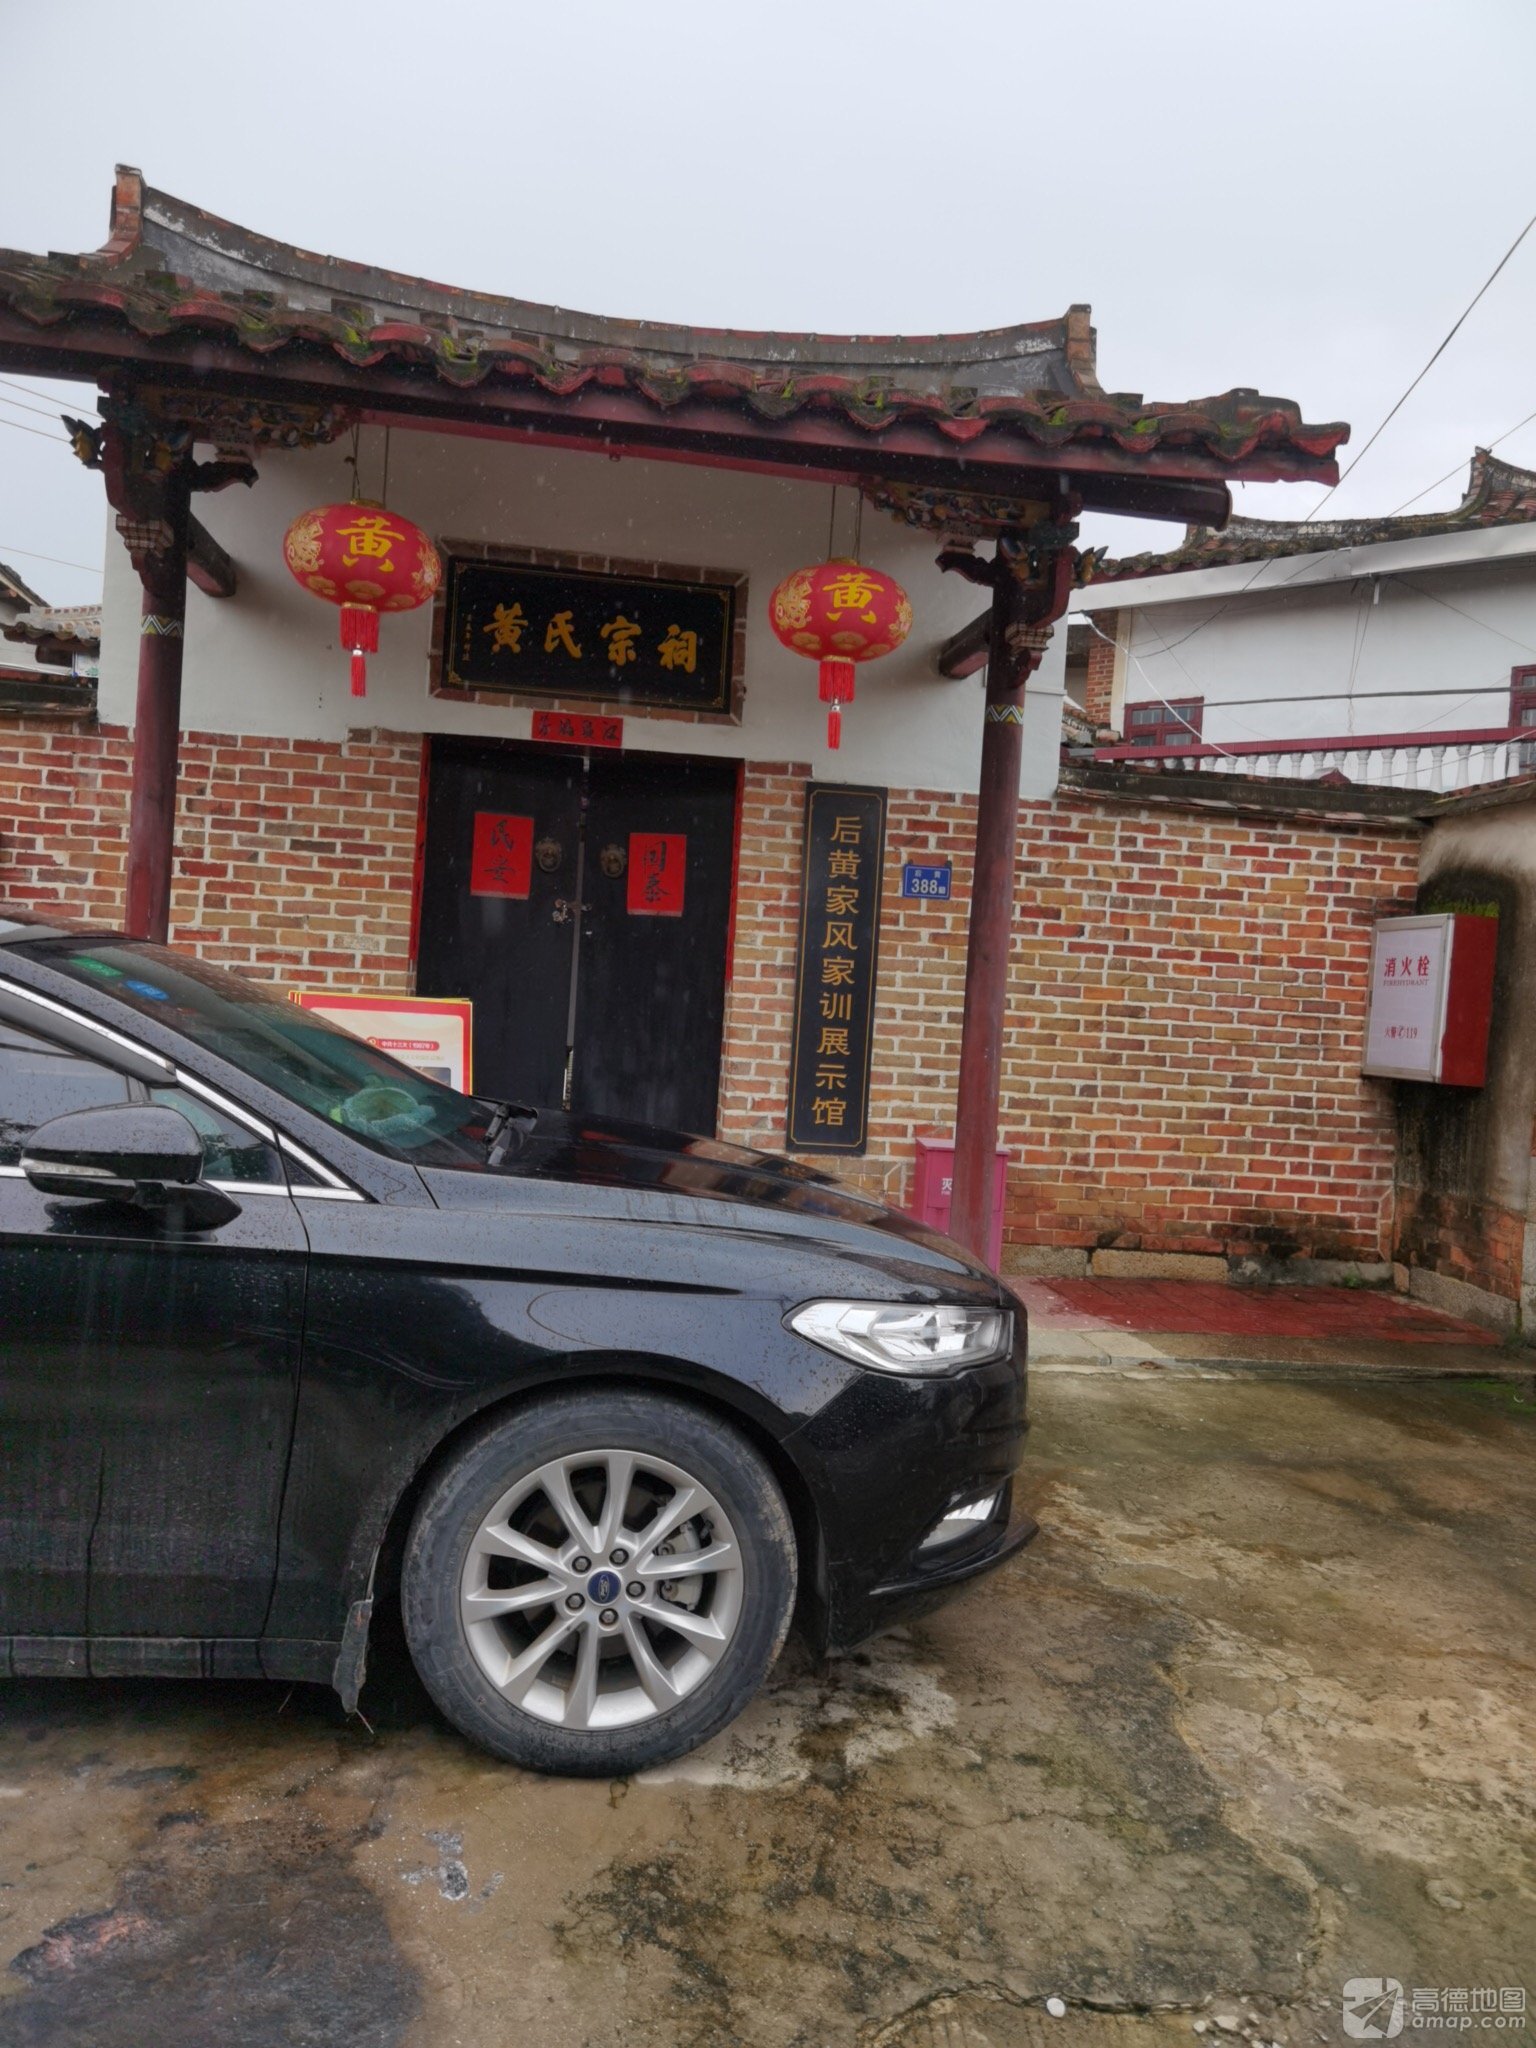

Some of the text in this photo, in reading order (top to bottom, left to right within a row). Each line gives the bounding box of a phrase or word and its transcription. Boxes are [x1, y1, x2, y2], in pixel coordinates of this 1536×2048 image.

[335, 516, 405, 572] 黄
[822, 572, 884, 624] 黄
[483, 602, 698, 673] 黄氏宗祠
[812, 815, 863, 1127] 后黄家风家训展示馆
[1384, 955, 1430, 977] 消火栓
